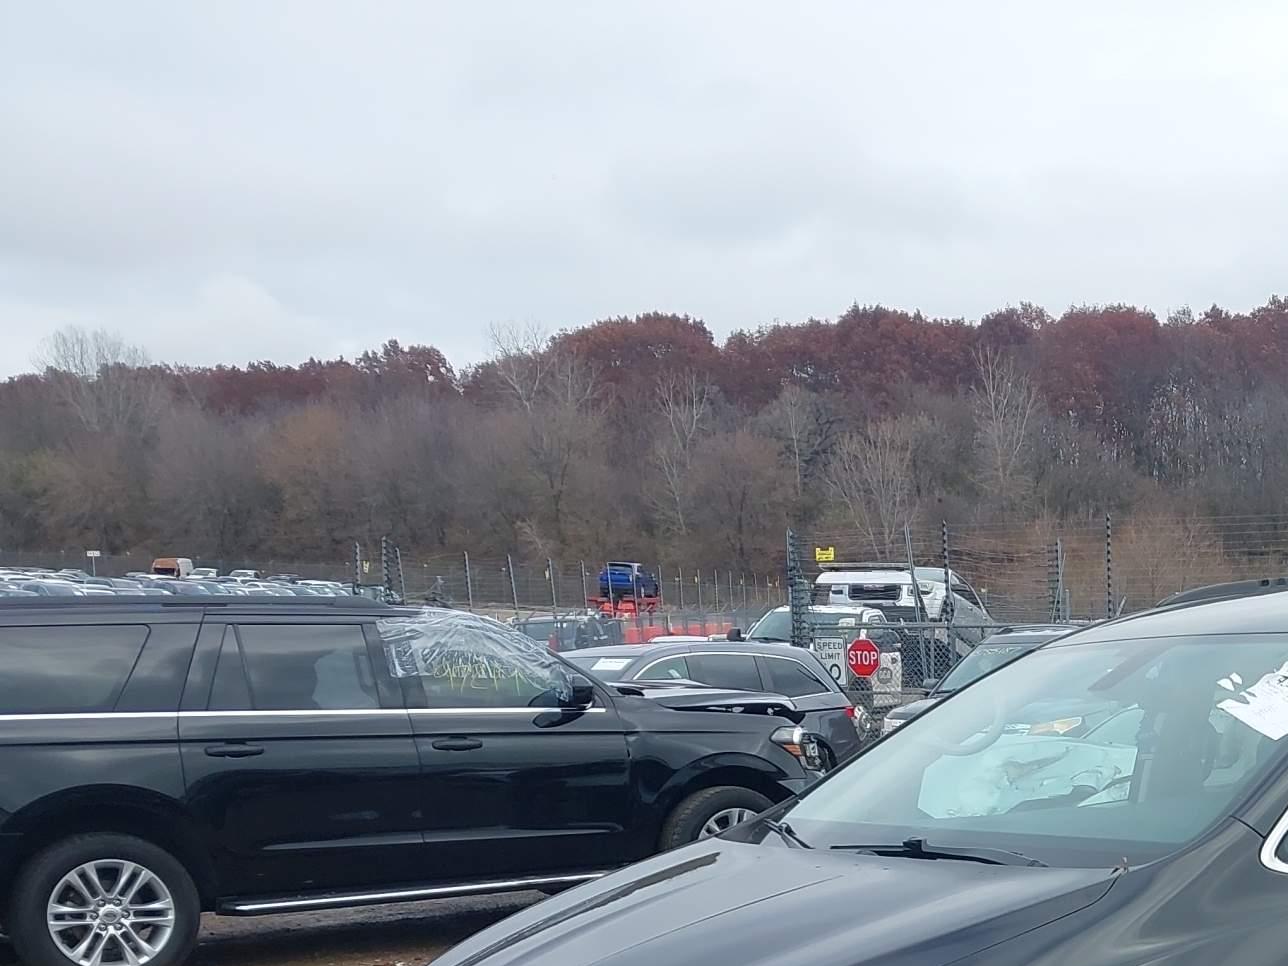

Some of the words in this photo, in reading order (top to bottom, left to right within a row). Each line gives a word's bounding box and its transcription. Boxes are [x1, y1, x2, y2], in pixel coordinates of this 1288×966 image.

[817, 641, 843, 650] SPEED
[820, 652, 840, 660] LIMIT
[849, 650, 878, 665] STOP
